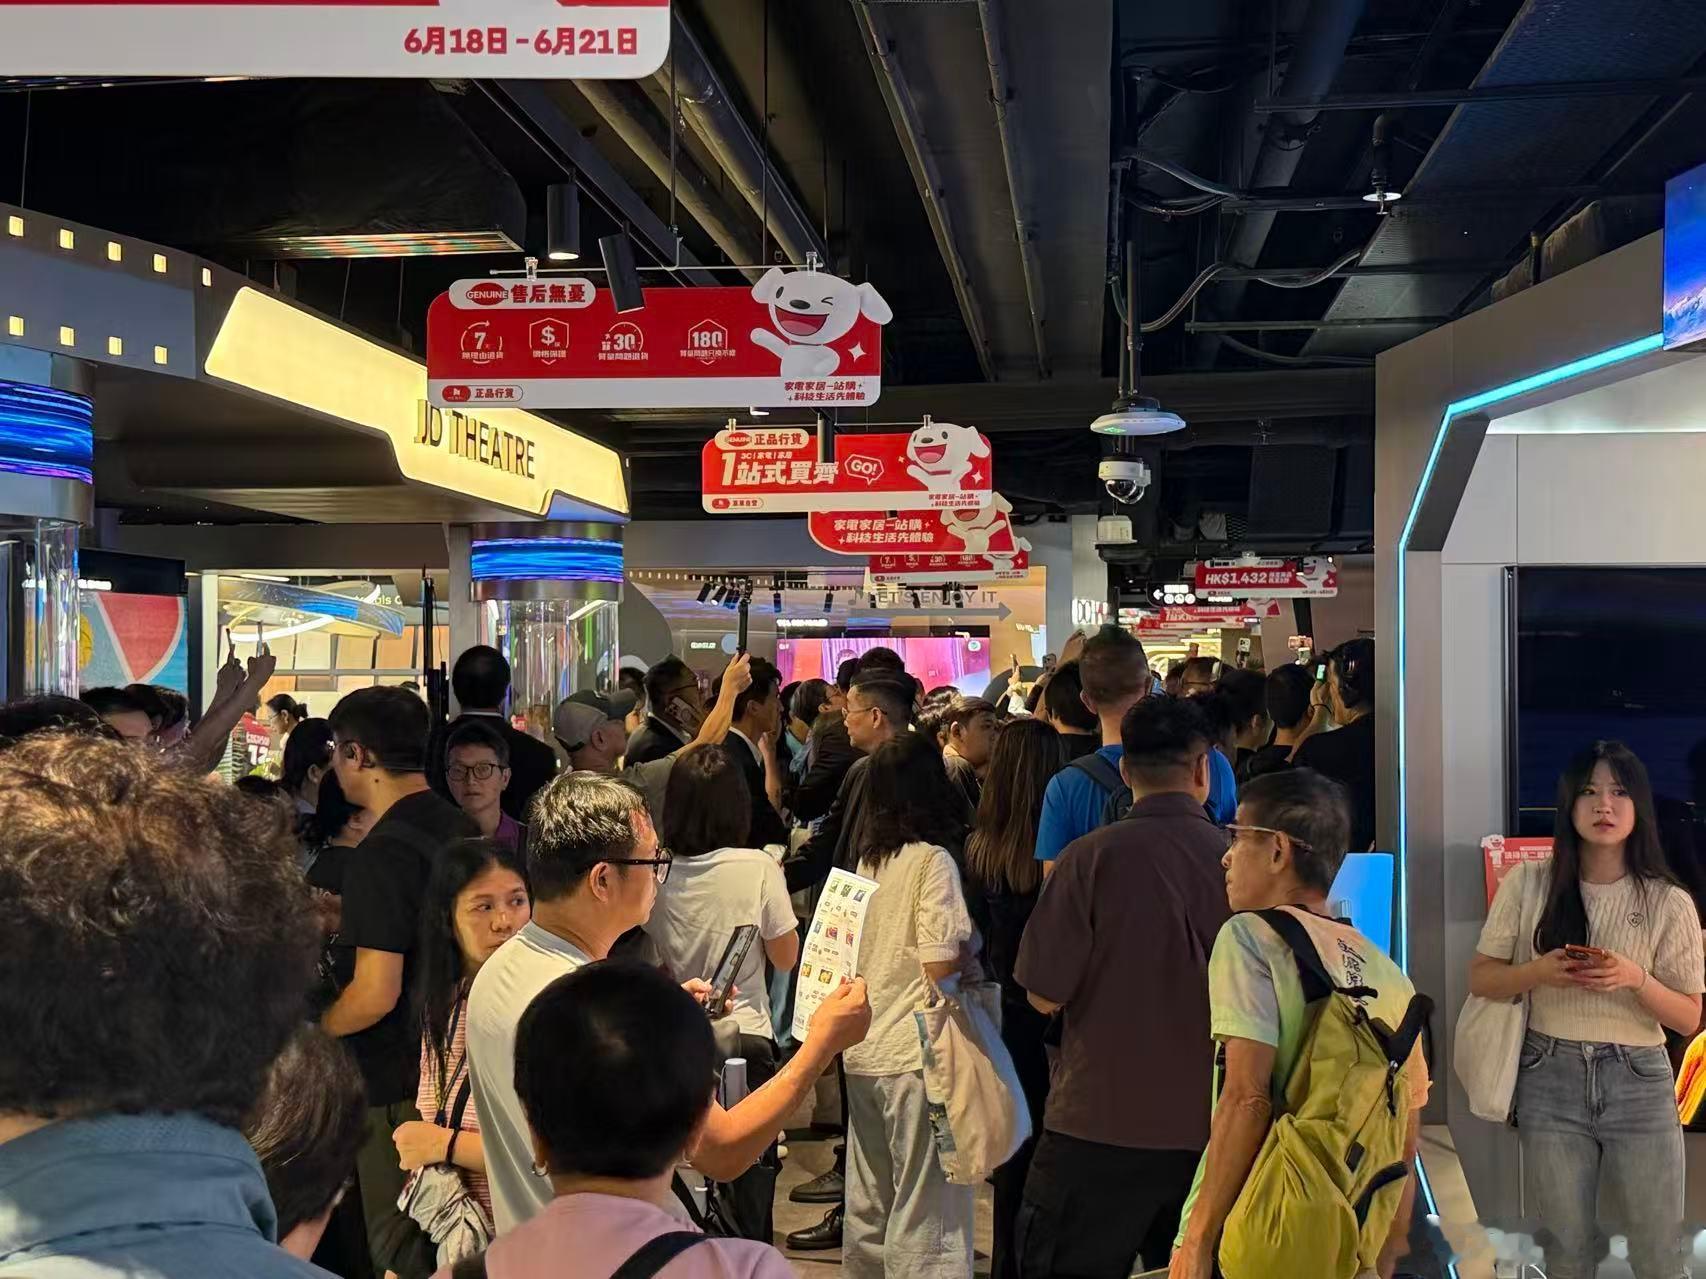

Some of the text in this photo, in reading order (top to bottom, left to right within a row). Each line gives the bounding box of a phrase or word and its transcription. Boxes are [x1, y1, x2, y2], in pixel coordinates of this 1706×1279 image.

[466, 289, 509, 299] GENUINE
[510, 283, 586, 303] 售后無憂
[784, 381, 856, 391] 家電家居一站購
[794, 392, 866, 401] 科技生活先體驗
[414, 399, 535, 480] JD THEATRE
[754, 433, 802, 446] 正品行貨
[850, 458, 878, 476] GO!
[834, 519, 922, 531] 家電家居一站購
[846, 532, 934, 544] 科技生活先體驗
[982, 590, 997, 603] IT
